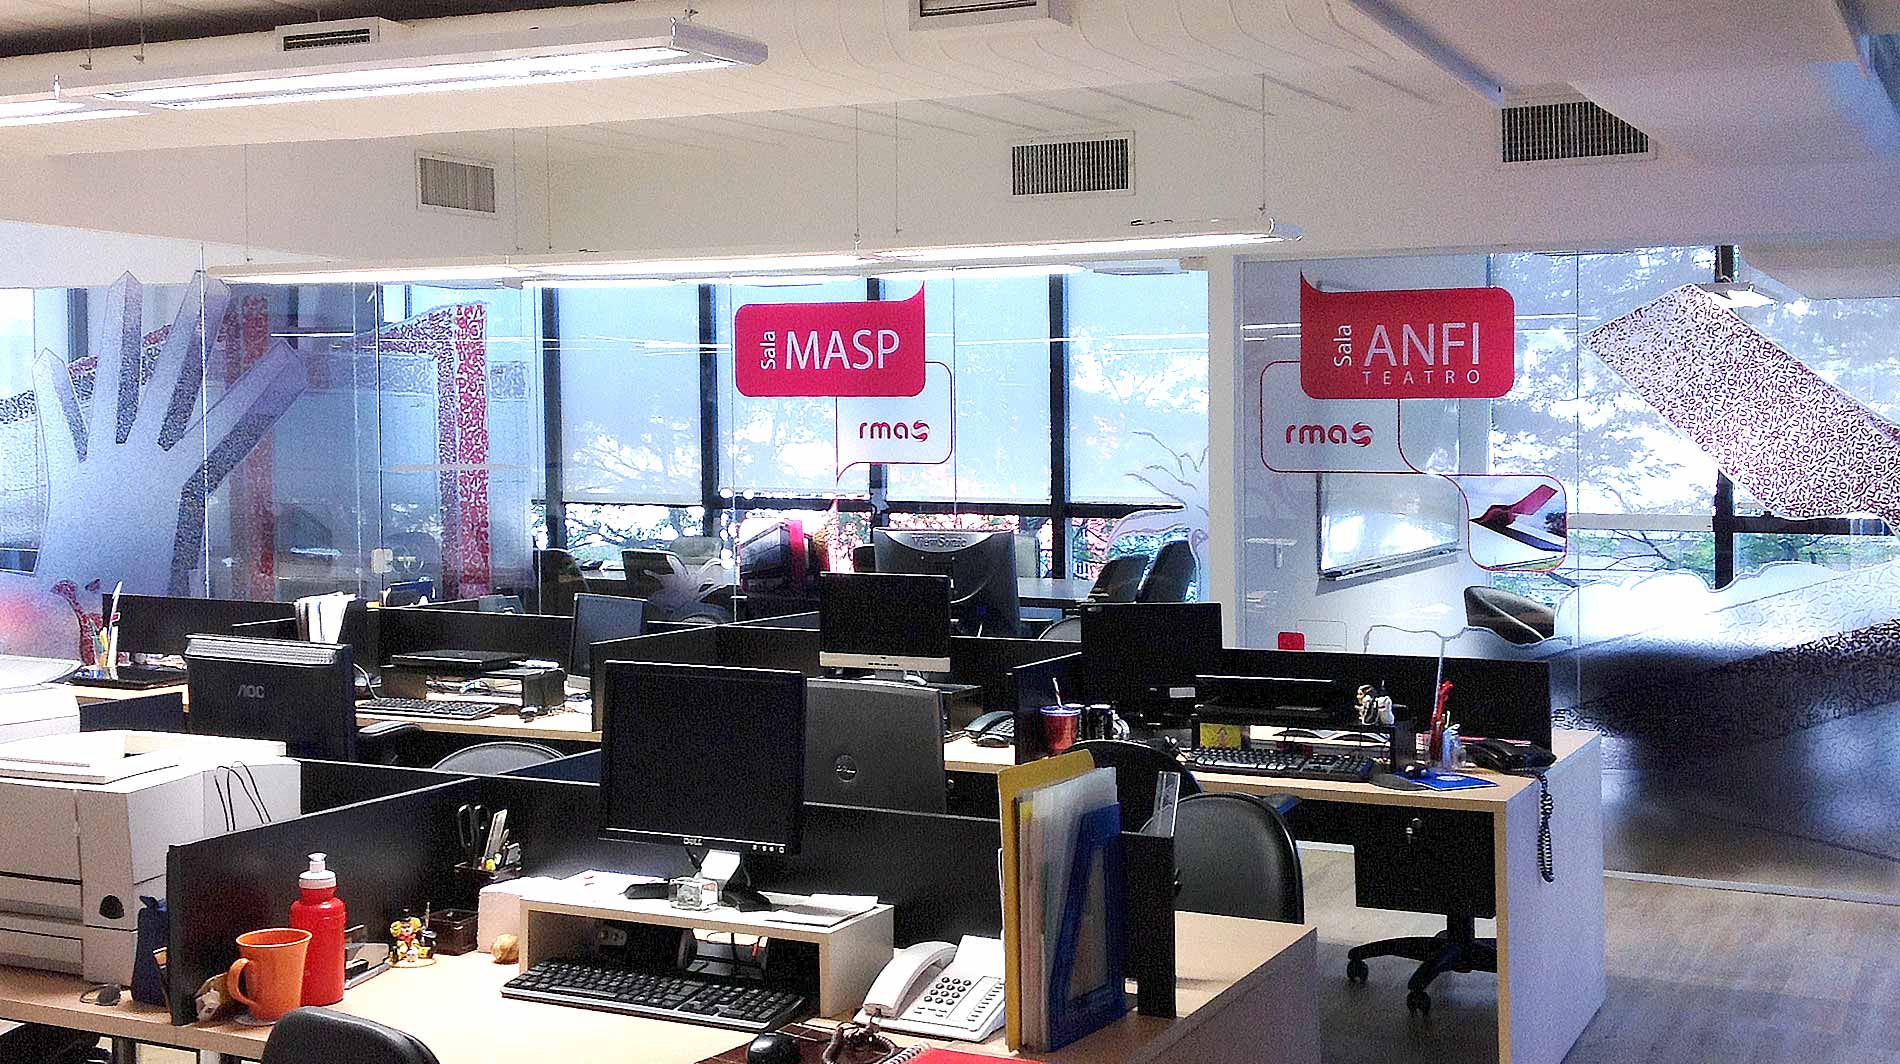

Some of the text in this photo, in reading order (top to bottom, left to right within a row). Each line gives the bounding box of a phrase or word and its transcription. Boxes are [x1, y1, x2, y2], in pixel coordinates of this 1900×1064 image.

[759, 330, 777, 370] Sala
[785, 329, 900, 370] MASP
[1333, 324, 1353, 367] Sala
[1363, 322, 1480, 367] ANFI
[1362, 369, 1480, 385] TEATRO
[237, 684, 265, 699] AOC
